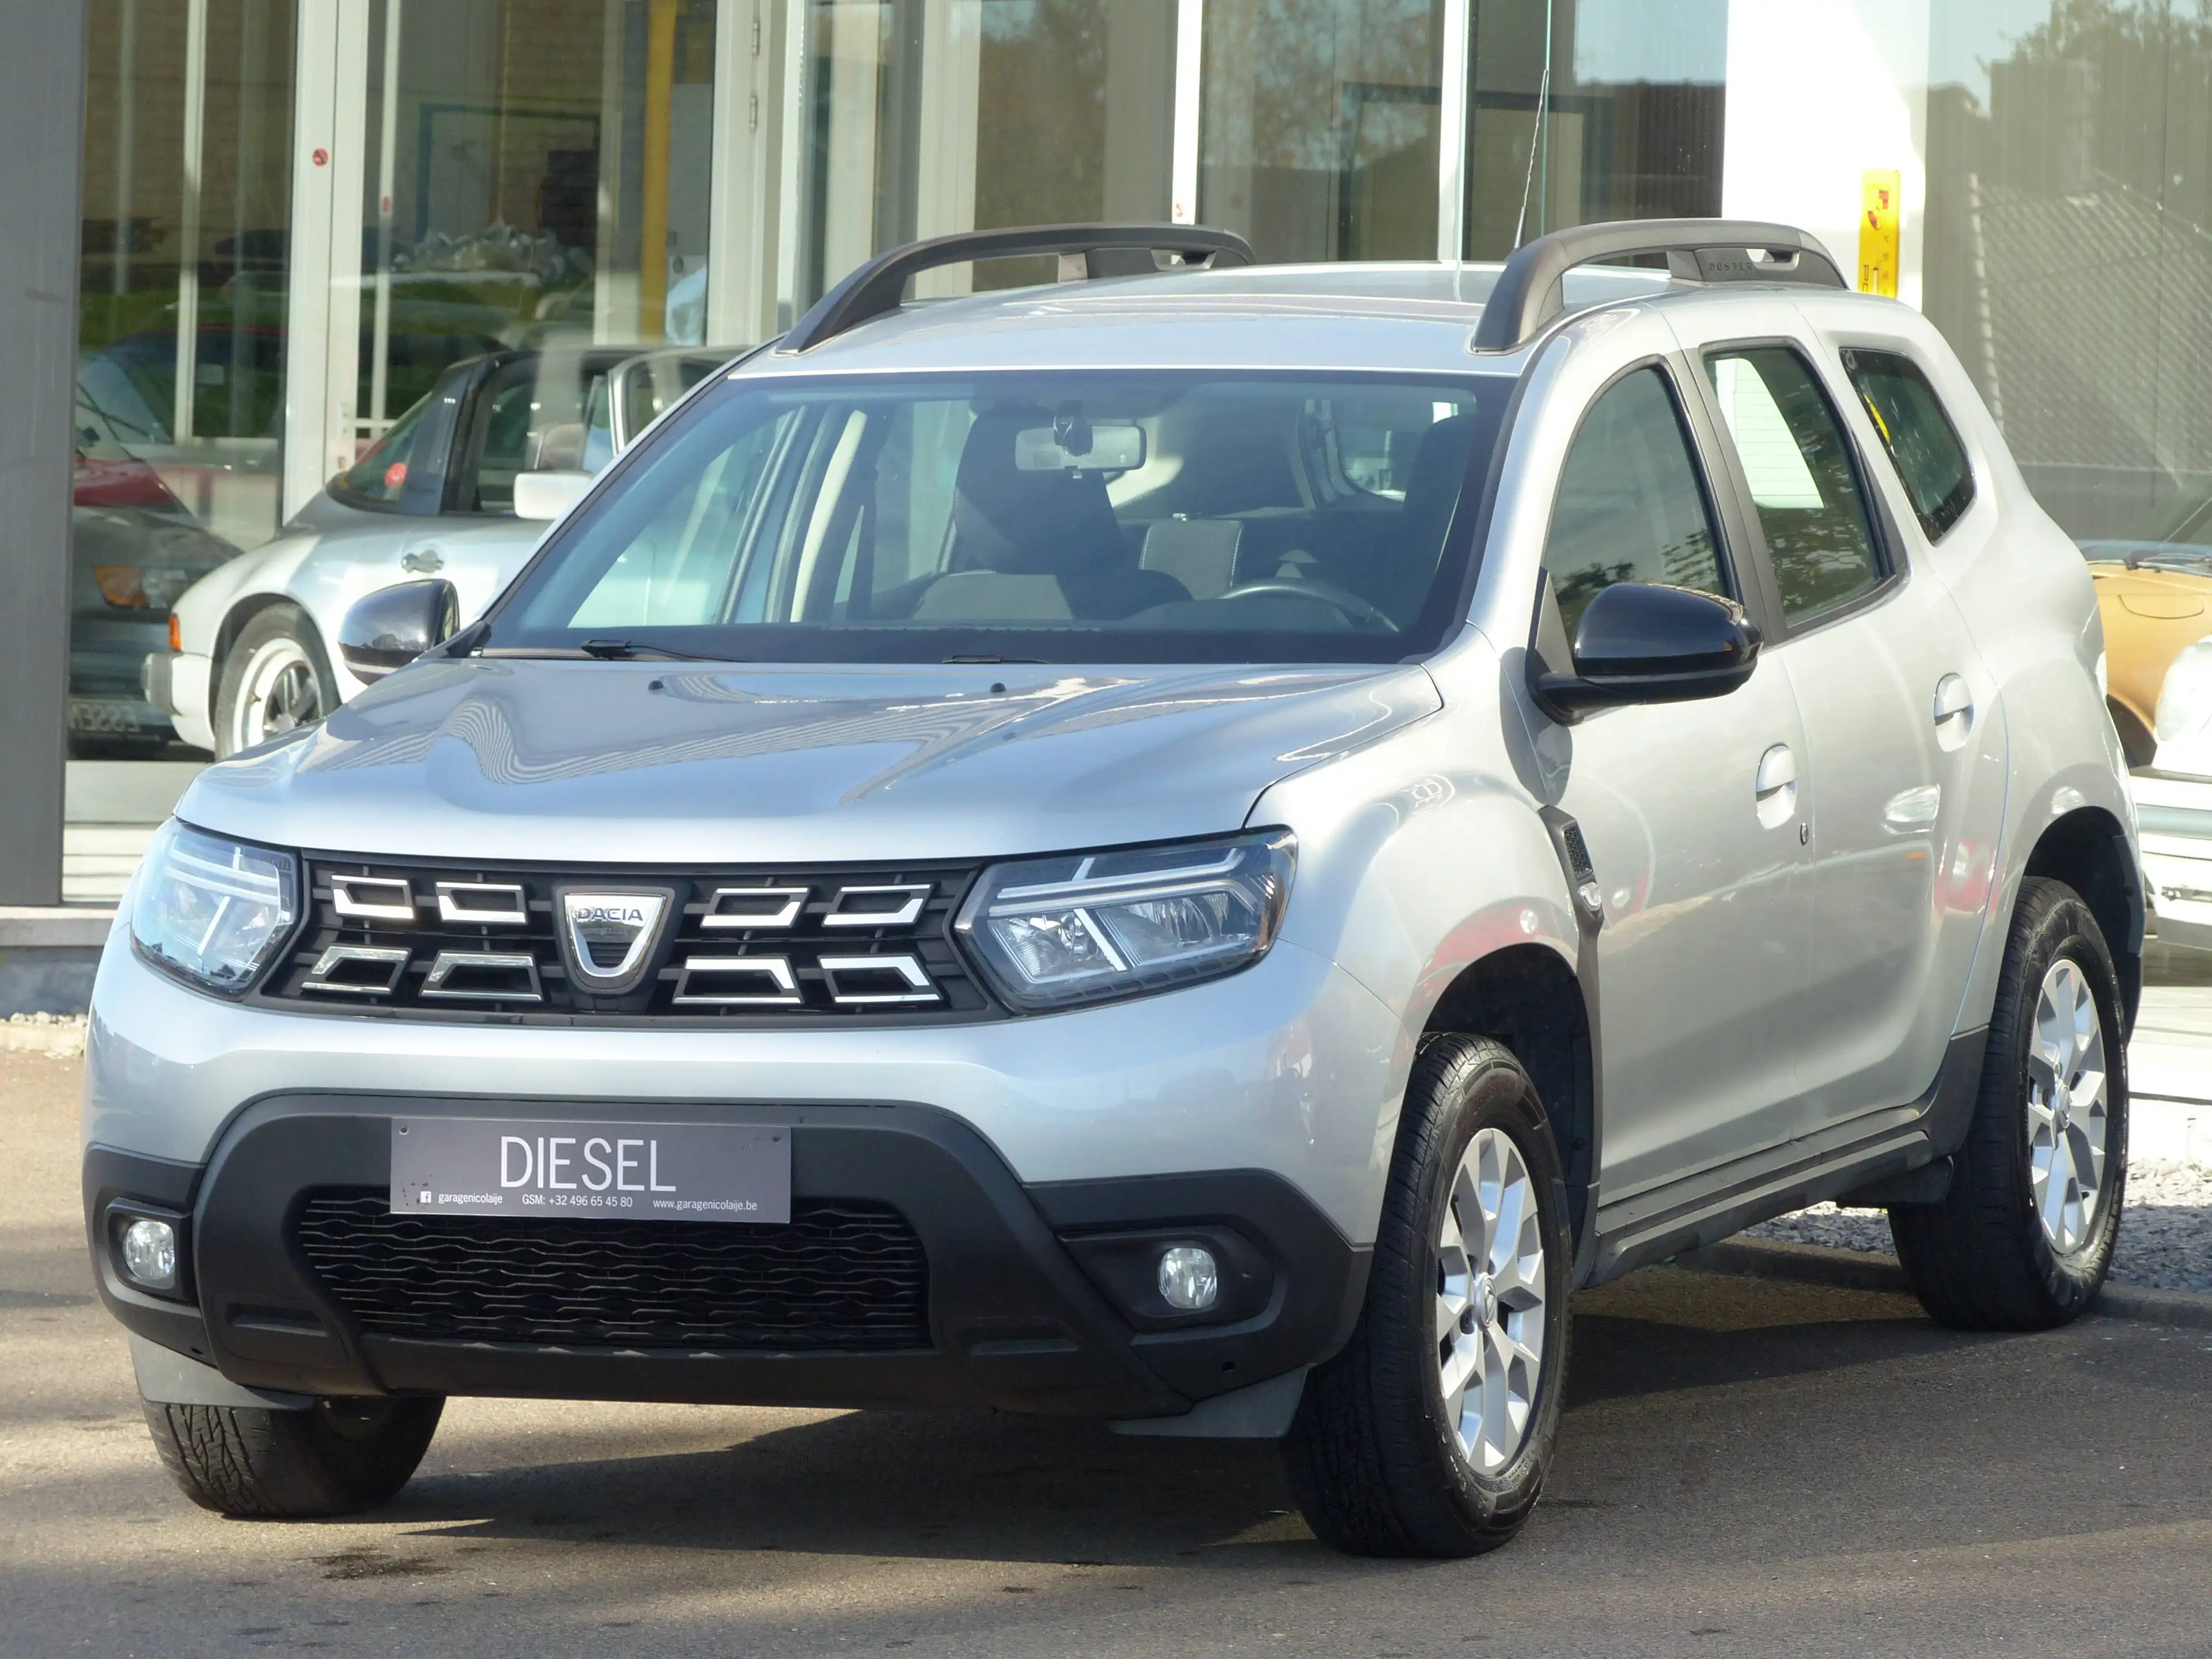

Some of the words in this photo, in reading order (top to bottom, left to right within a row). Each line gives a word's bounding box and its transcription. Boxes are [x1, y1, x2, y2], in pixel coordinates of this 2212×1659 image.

[1709, 262, 1753, 272] DUSTER
[578, 908, 643, 921] DACIA
[501, 1136, 676, 1191] DIESEL
[438, 1193, 503, 1206] garagenicolaije
[522, 1194, 546, 1205] GSM:
[548, 1195, 567, 1206] +32
[569, 1195, 588, 1206] 496
[590, 1196, 603, 1206] 65
[605, 1196, 618, 1207] 45
[620, 1196, 633, 1207] 80
[653, 1199, 757, 1211] www.garagenicolaije.be
